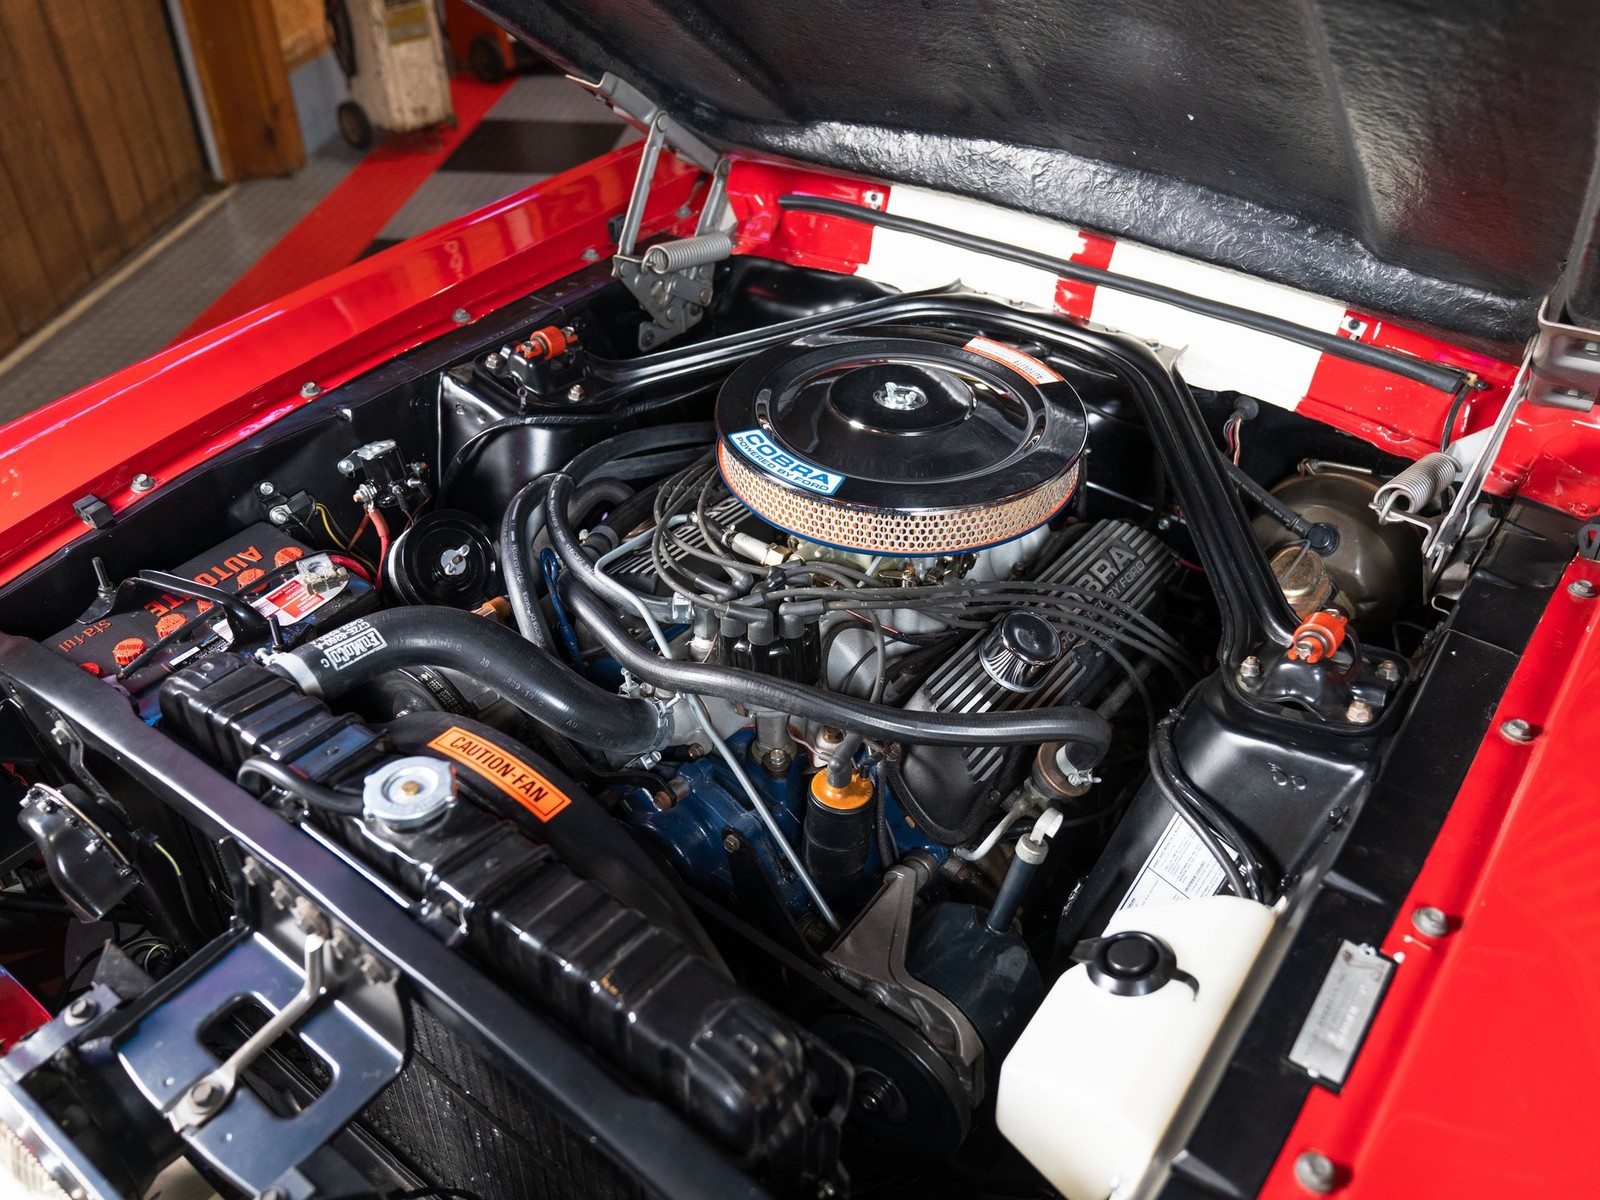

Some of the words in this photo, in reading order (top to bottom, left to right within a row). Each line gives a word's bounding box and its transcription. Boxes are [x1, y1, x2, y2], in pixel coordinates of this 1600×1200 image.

[735, 436, 777, 469] POWERED
[777, 467, 794, 478] BY
[794, 475, 829, 491] FORD
[745, 433, 829, 485] COBRA
[143, 545, 263, 617] AUTOTE
[1120, 560, 1145, 588] FORD
[449, 736, 549, 803] CAUTION-FAN
